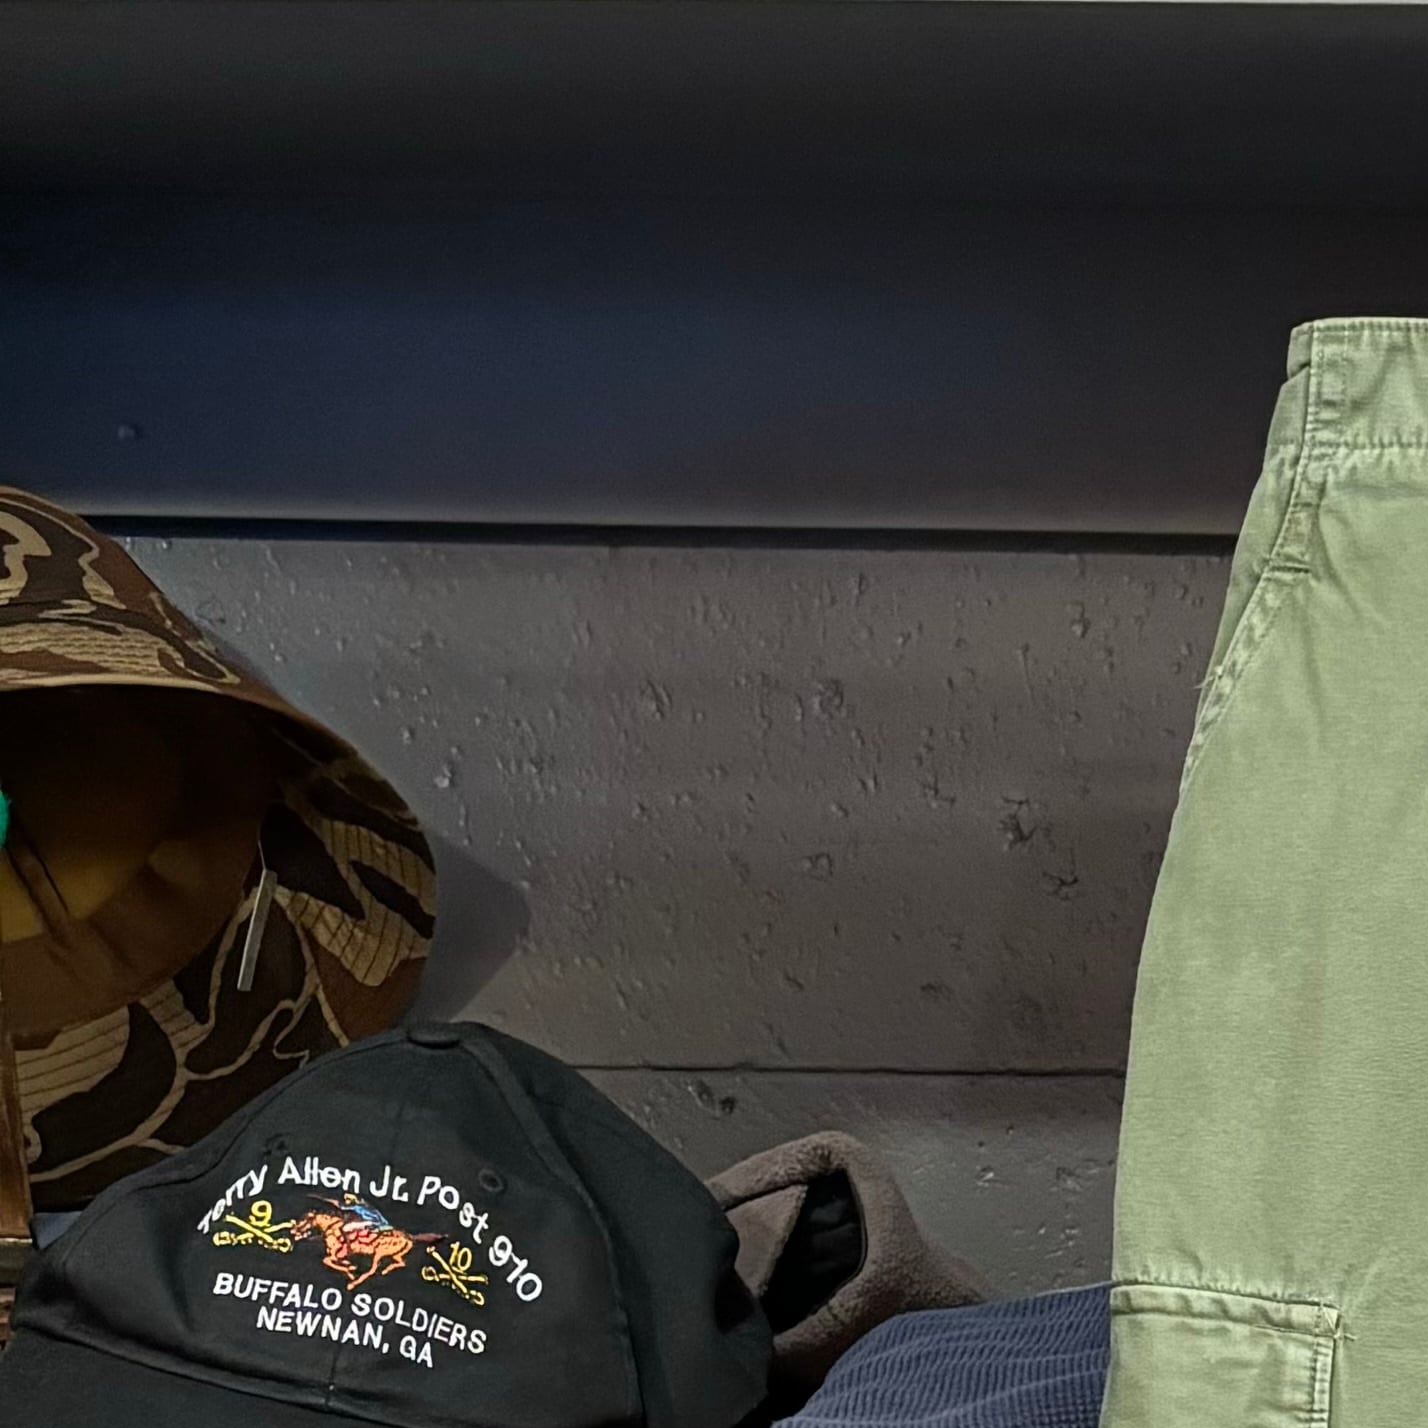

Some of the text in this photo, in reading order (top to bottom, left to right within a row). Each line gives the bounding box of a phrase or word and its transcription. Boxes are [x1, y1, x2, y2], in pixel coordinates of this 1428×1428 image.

[197, 1164, 268, 1234] Terry
[277, 1155, 360, 1194] Allen
[416, 1175, 489, 1244] Post
[488, 1235, 543, 1301] 910
[249, 1199, 272, 1227] 9
[213, 1272, 487, 1354] BUFFALO SOLDIERS
[256, 1305, 433, 1368] NEWNAN, GA
